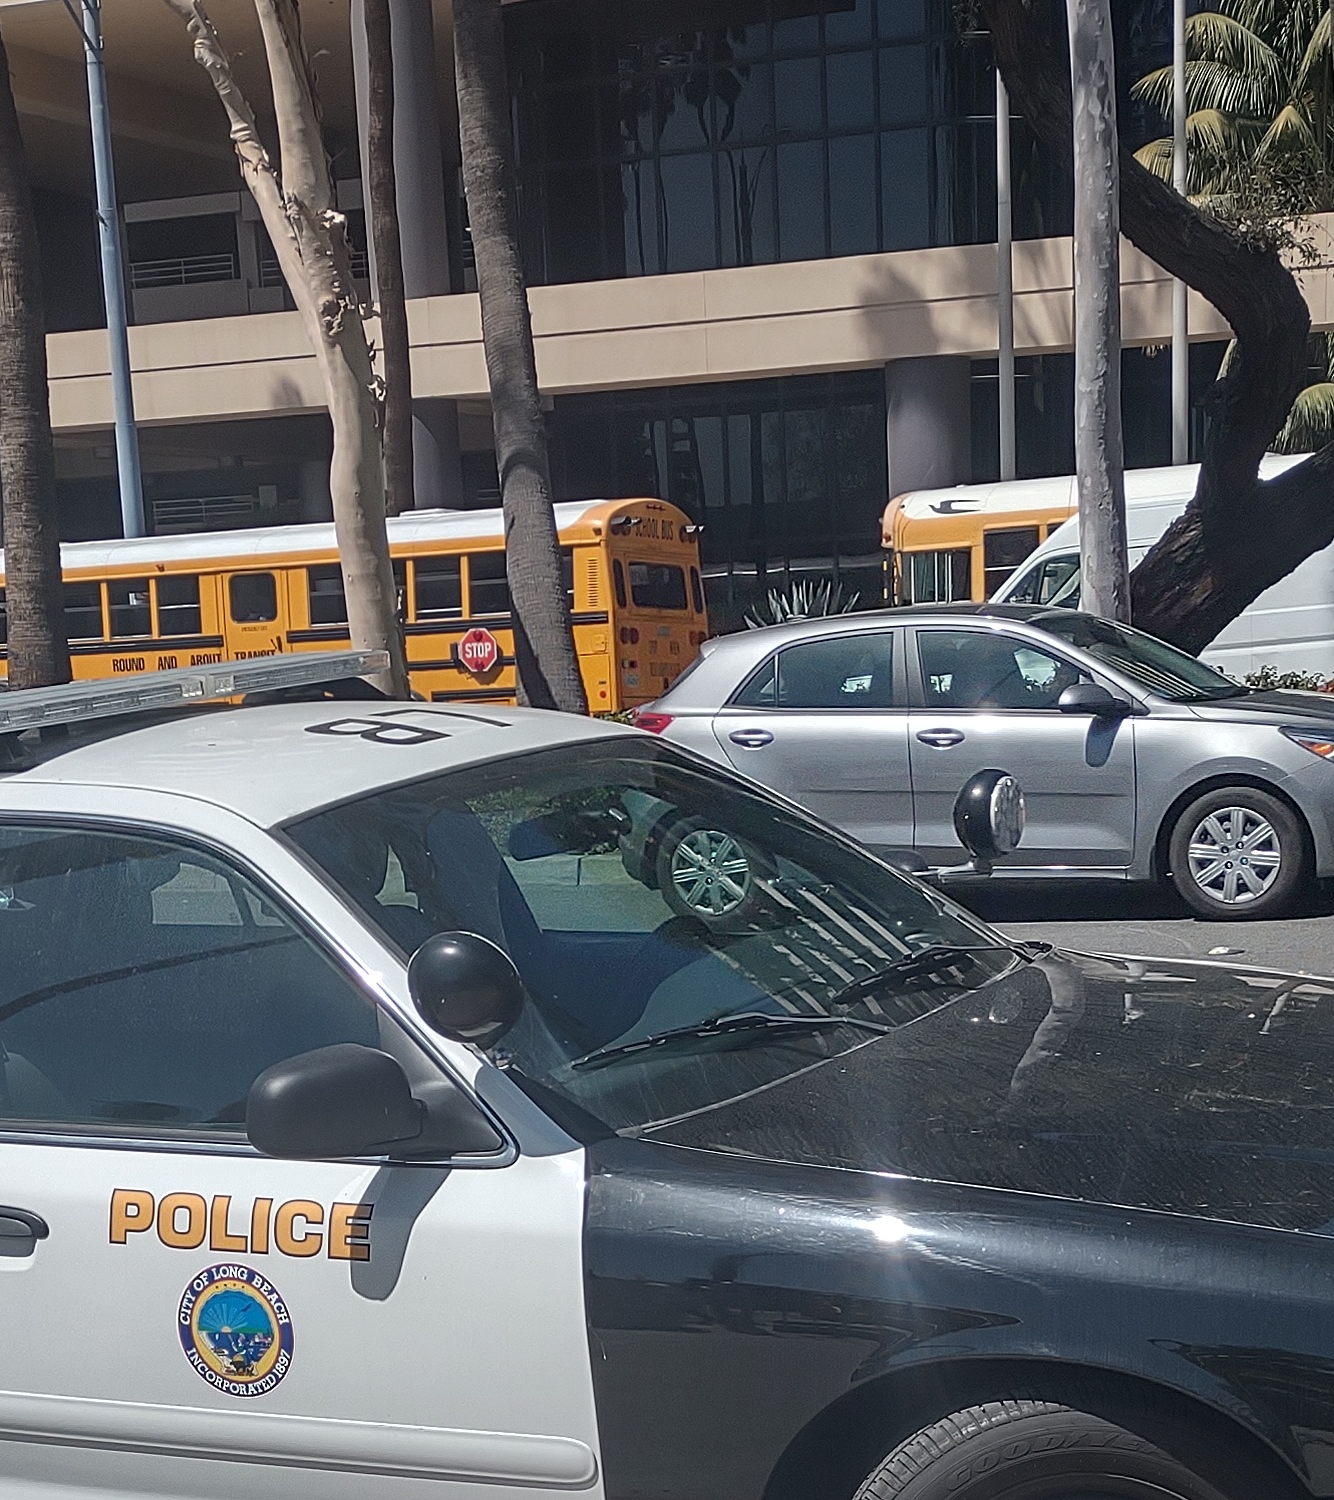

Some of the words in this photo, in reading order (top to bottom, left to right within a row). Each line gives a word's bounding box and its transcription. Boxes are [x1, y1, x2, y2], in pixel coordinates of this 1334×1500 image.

[634, 517, 660, 540] SCHOOL
[661, 519, 674, 541] BUS
[113, 658, 145, 672] ROUND
[157, 655, 178, 670] AND
[190, 653, 222, 666] ABOUT
[464, 641, 492, 659] STOP
[109, 1188, 375, 1262] POLICE
[179, 1291, 196, 1325] CITY
[193, 1272, 209, 1291] OF
[211, 1265, 248, 1280] LONG
[251, 1274, 290, 1325] BEACH
[186, 1347, 277, 1395] INCORPORATED
[273, 1349, 291, 1379] 1897
[946, 1432, 1175, 1491] GOODYE
